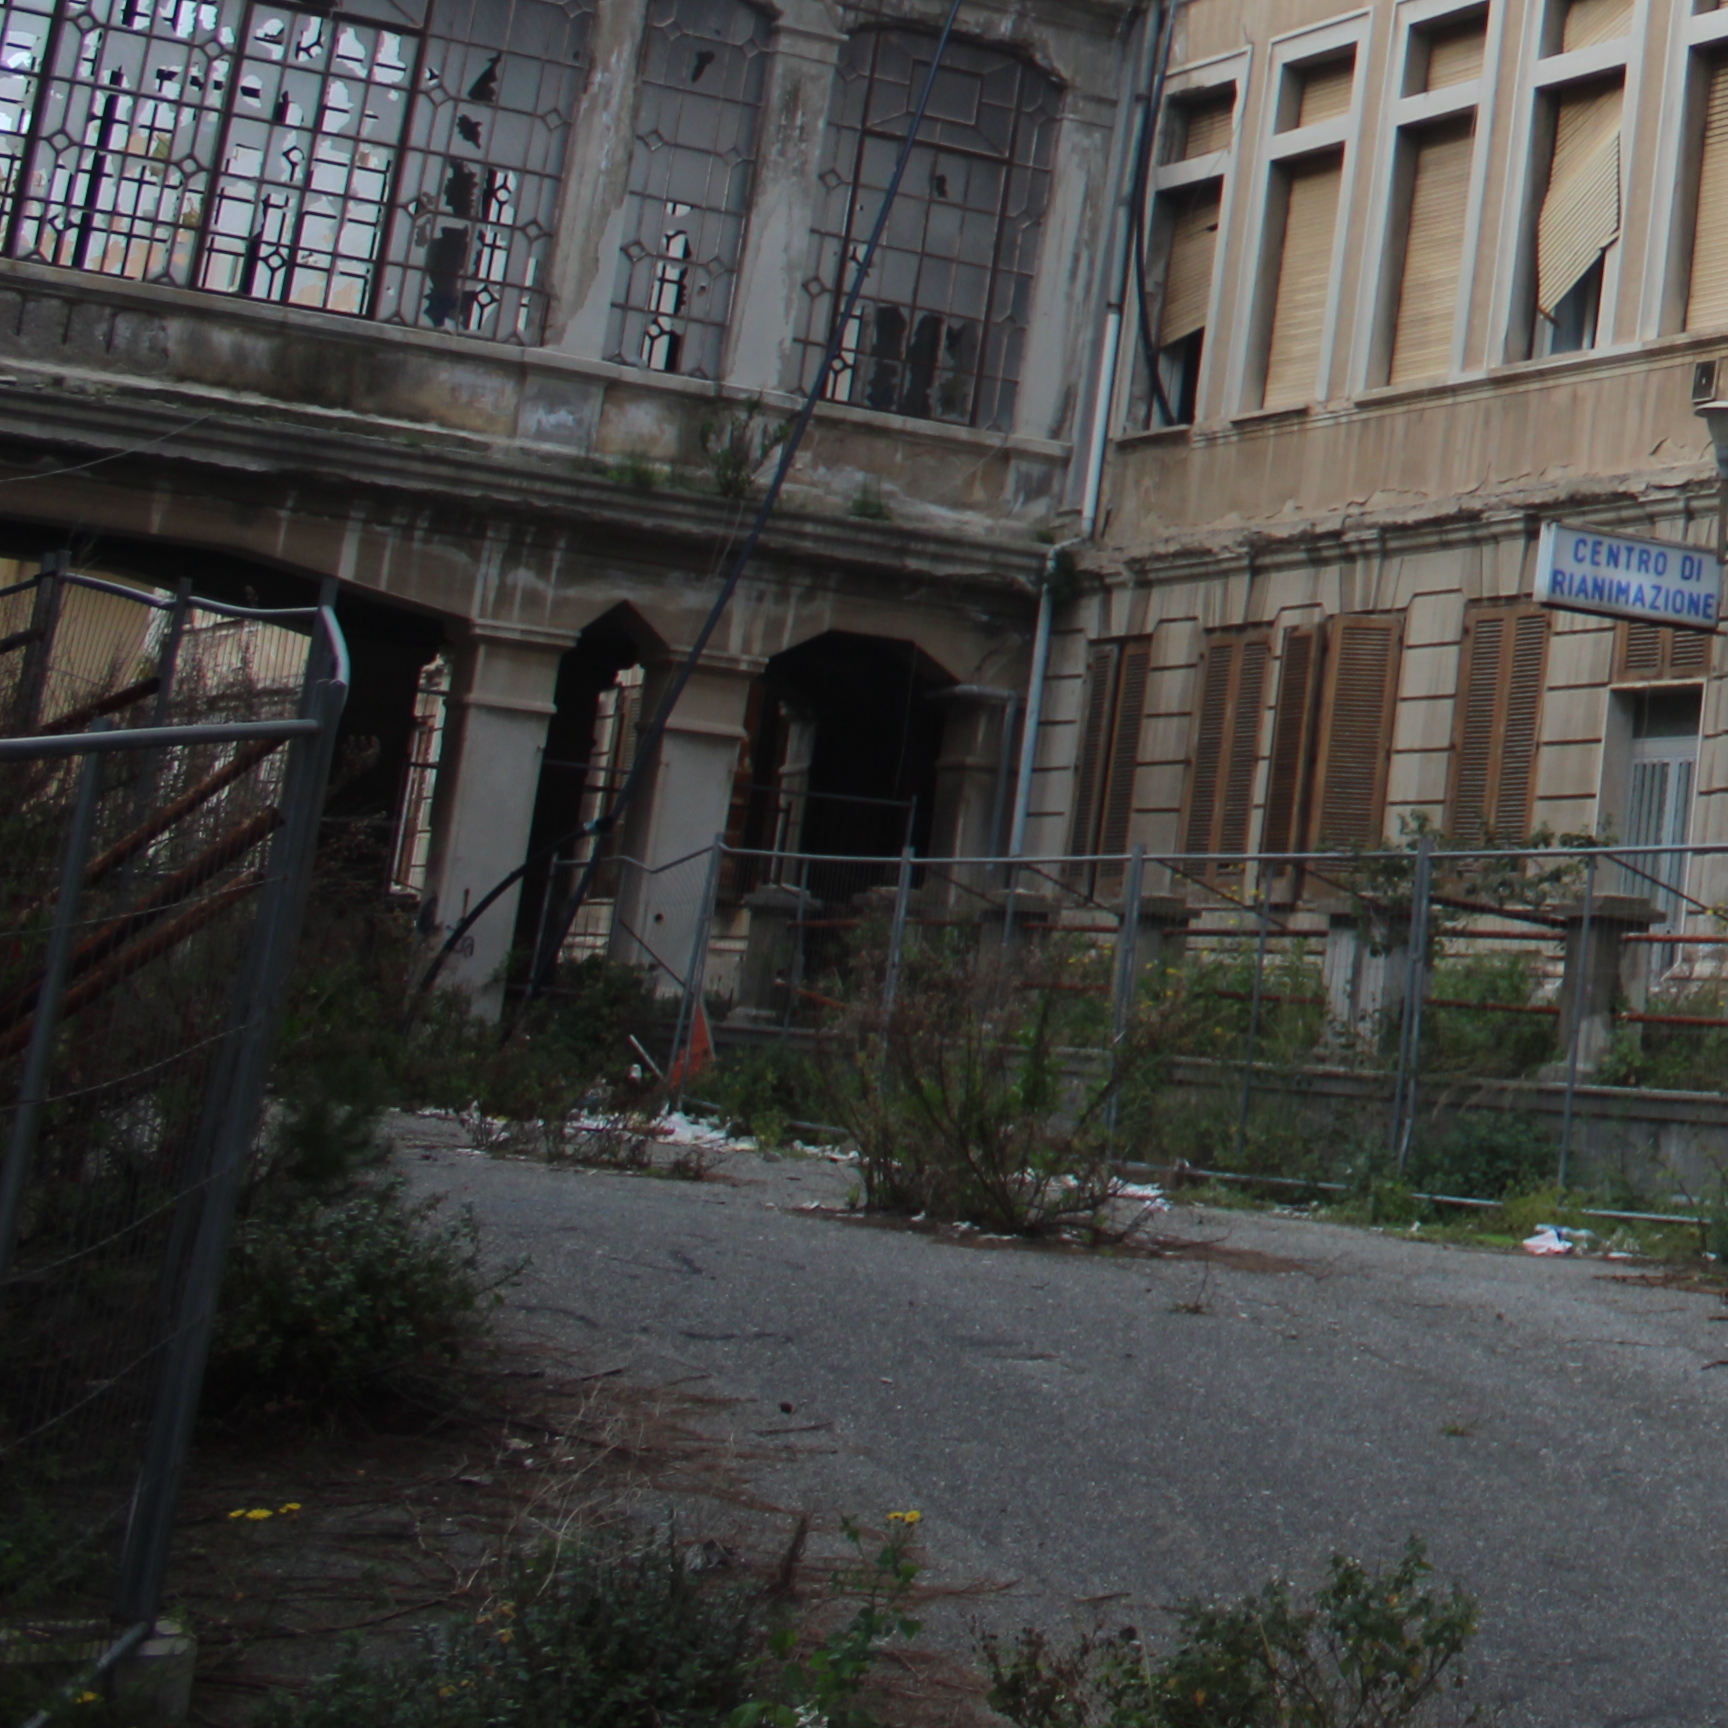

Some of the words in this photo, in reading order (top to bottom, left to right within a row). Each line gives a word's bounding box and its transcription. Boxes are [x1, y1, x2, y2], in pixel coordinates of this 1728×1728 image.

[1573, 537, 1668, 576] CENTRO
[1680, 554, 1703, 582] DI
[1551, 569, 1716, 620] RIANIMAZIONE
